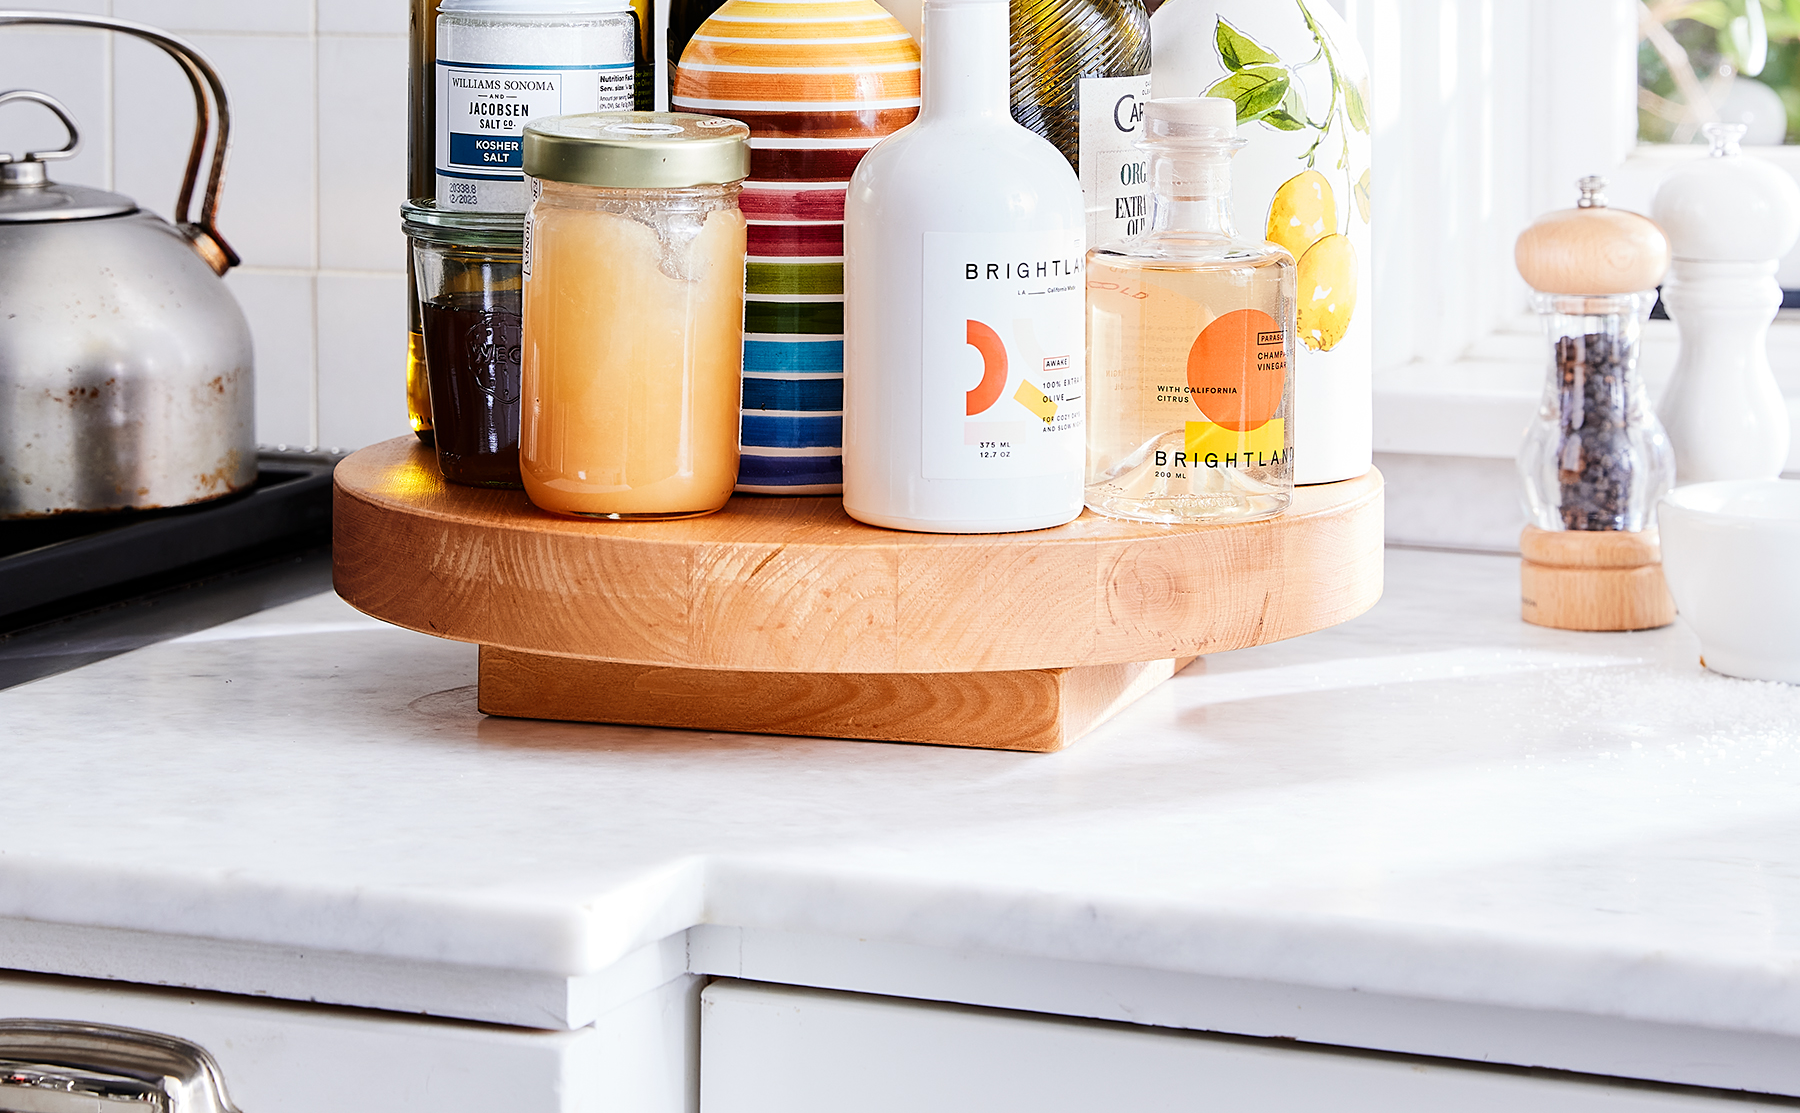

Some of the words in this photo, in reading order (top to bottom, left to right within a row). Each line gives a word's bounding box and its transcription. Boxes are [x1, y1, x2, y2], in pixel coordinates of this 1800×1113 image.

[600, 74, 624, 83] Nutrition
[452, 77, 501, 90] WILLIAMS
[504, 80, 555, 91] SONOMA
[469, 102, 529, 117] JACOBSEN
[480, 119, 500, 129] SALT
[503, 120, 516, 129] CO.
[475, 140, 519, 151] KOSHER
[483, 153, 509, 163] SALT
[1121, 161, 1147, 186] ORG
[1046, 358, 1067, 368] AWAKE
[1042, 380, 1061, 390] 100%
[1042, 393, 1064, 404] OLIVE
[1157, 394, 1190, 404] CITRUS
[1154, 470, 1171, 478] 200
